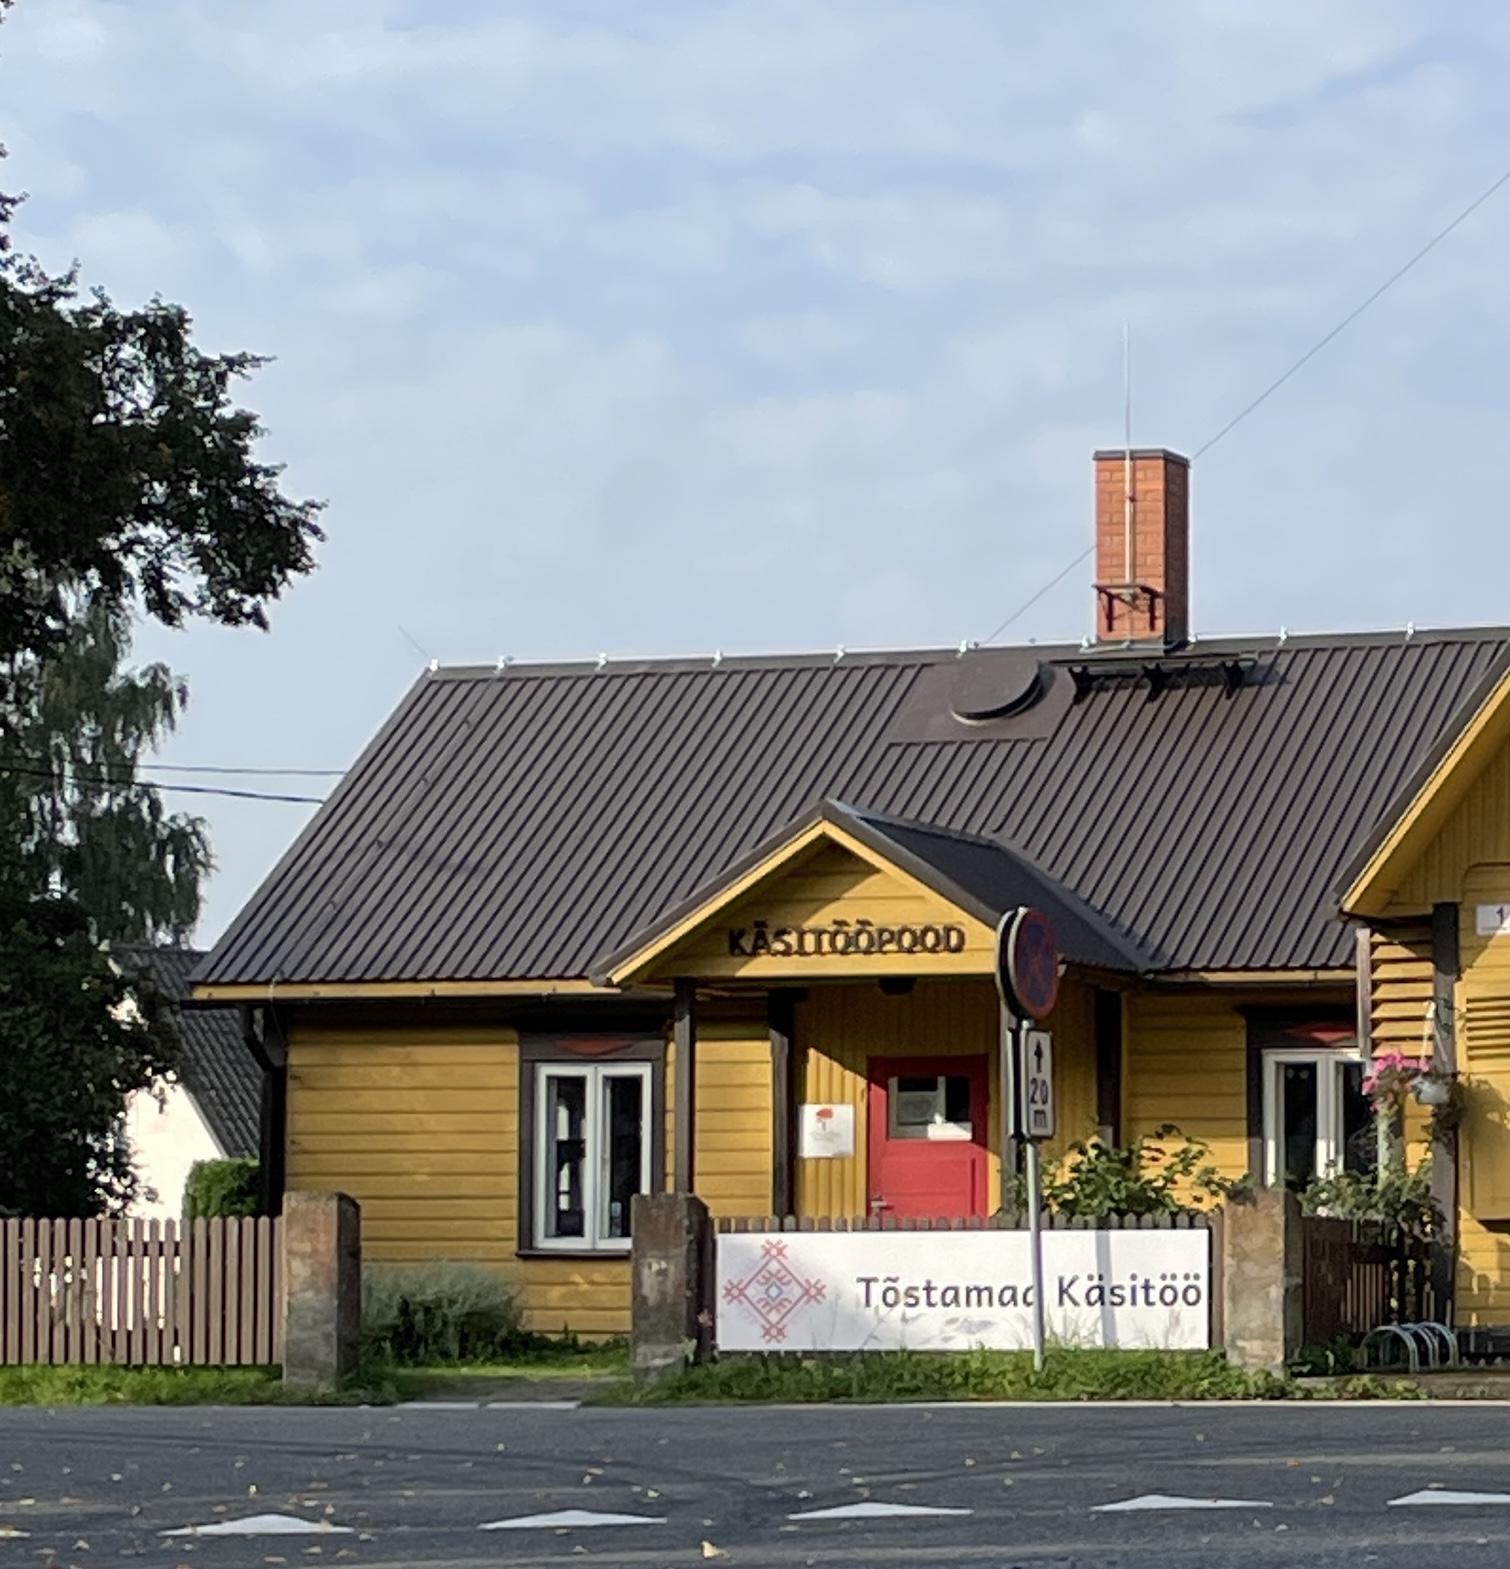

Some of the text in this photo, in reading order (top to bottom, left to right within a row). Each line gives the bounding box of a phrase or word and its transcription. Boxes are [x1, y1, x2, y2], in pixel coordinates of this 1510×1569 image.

[1496, 906, 1504, 926] 1
[728, 918, 967, 957] KÄSITÖÖPOOD
[1030, 1078, 1049, 1105] 20
[1033, 1110, 1048, 1129] m
[1058, 1273, 1203, 1307] Käsitöö
